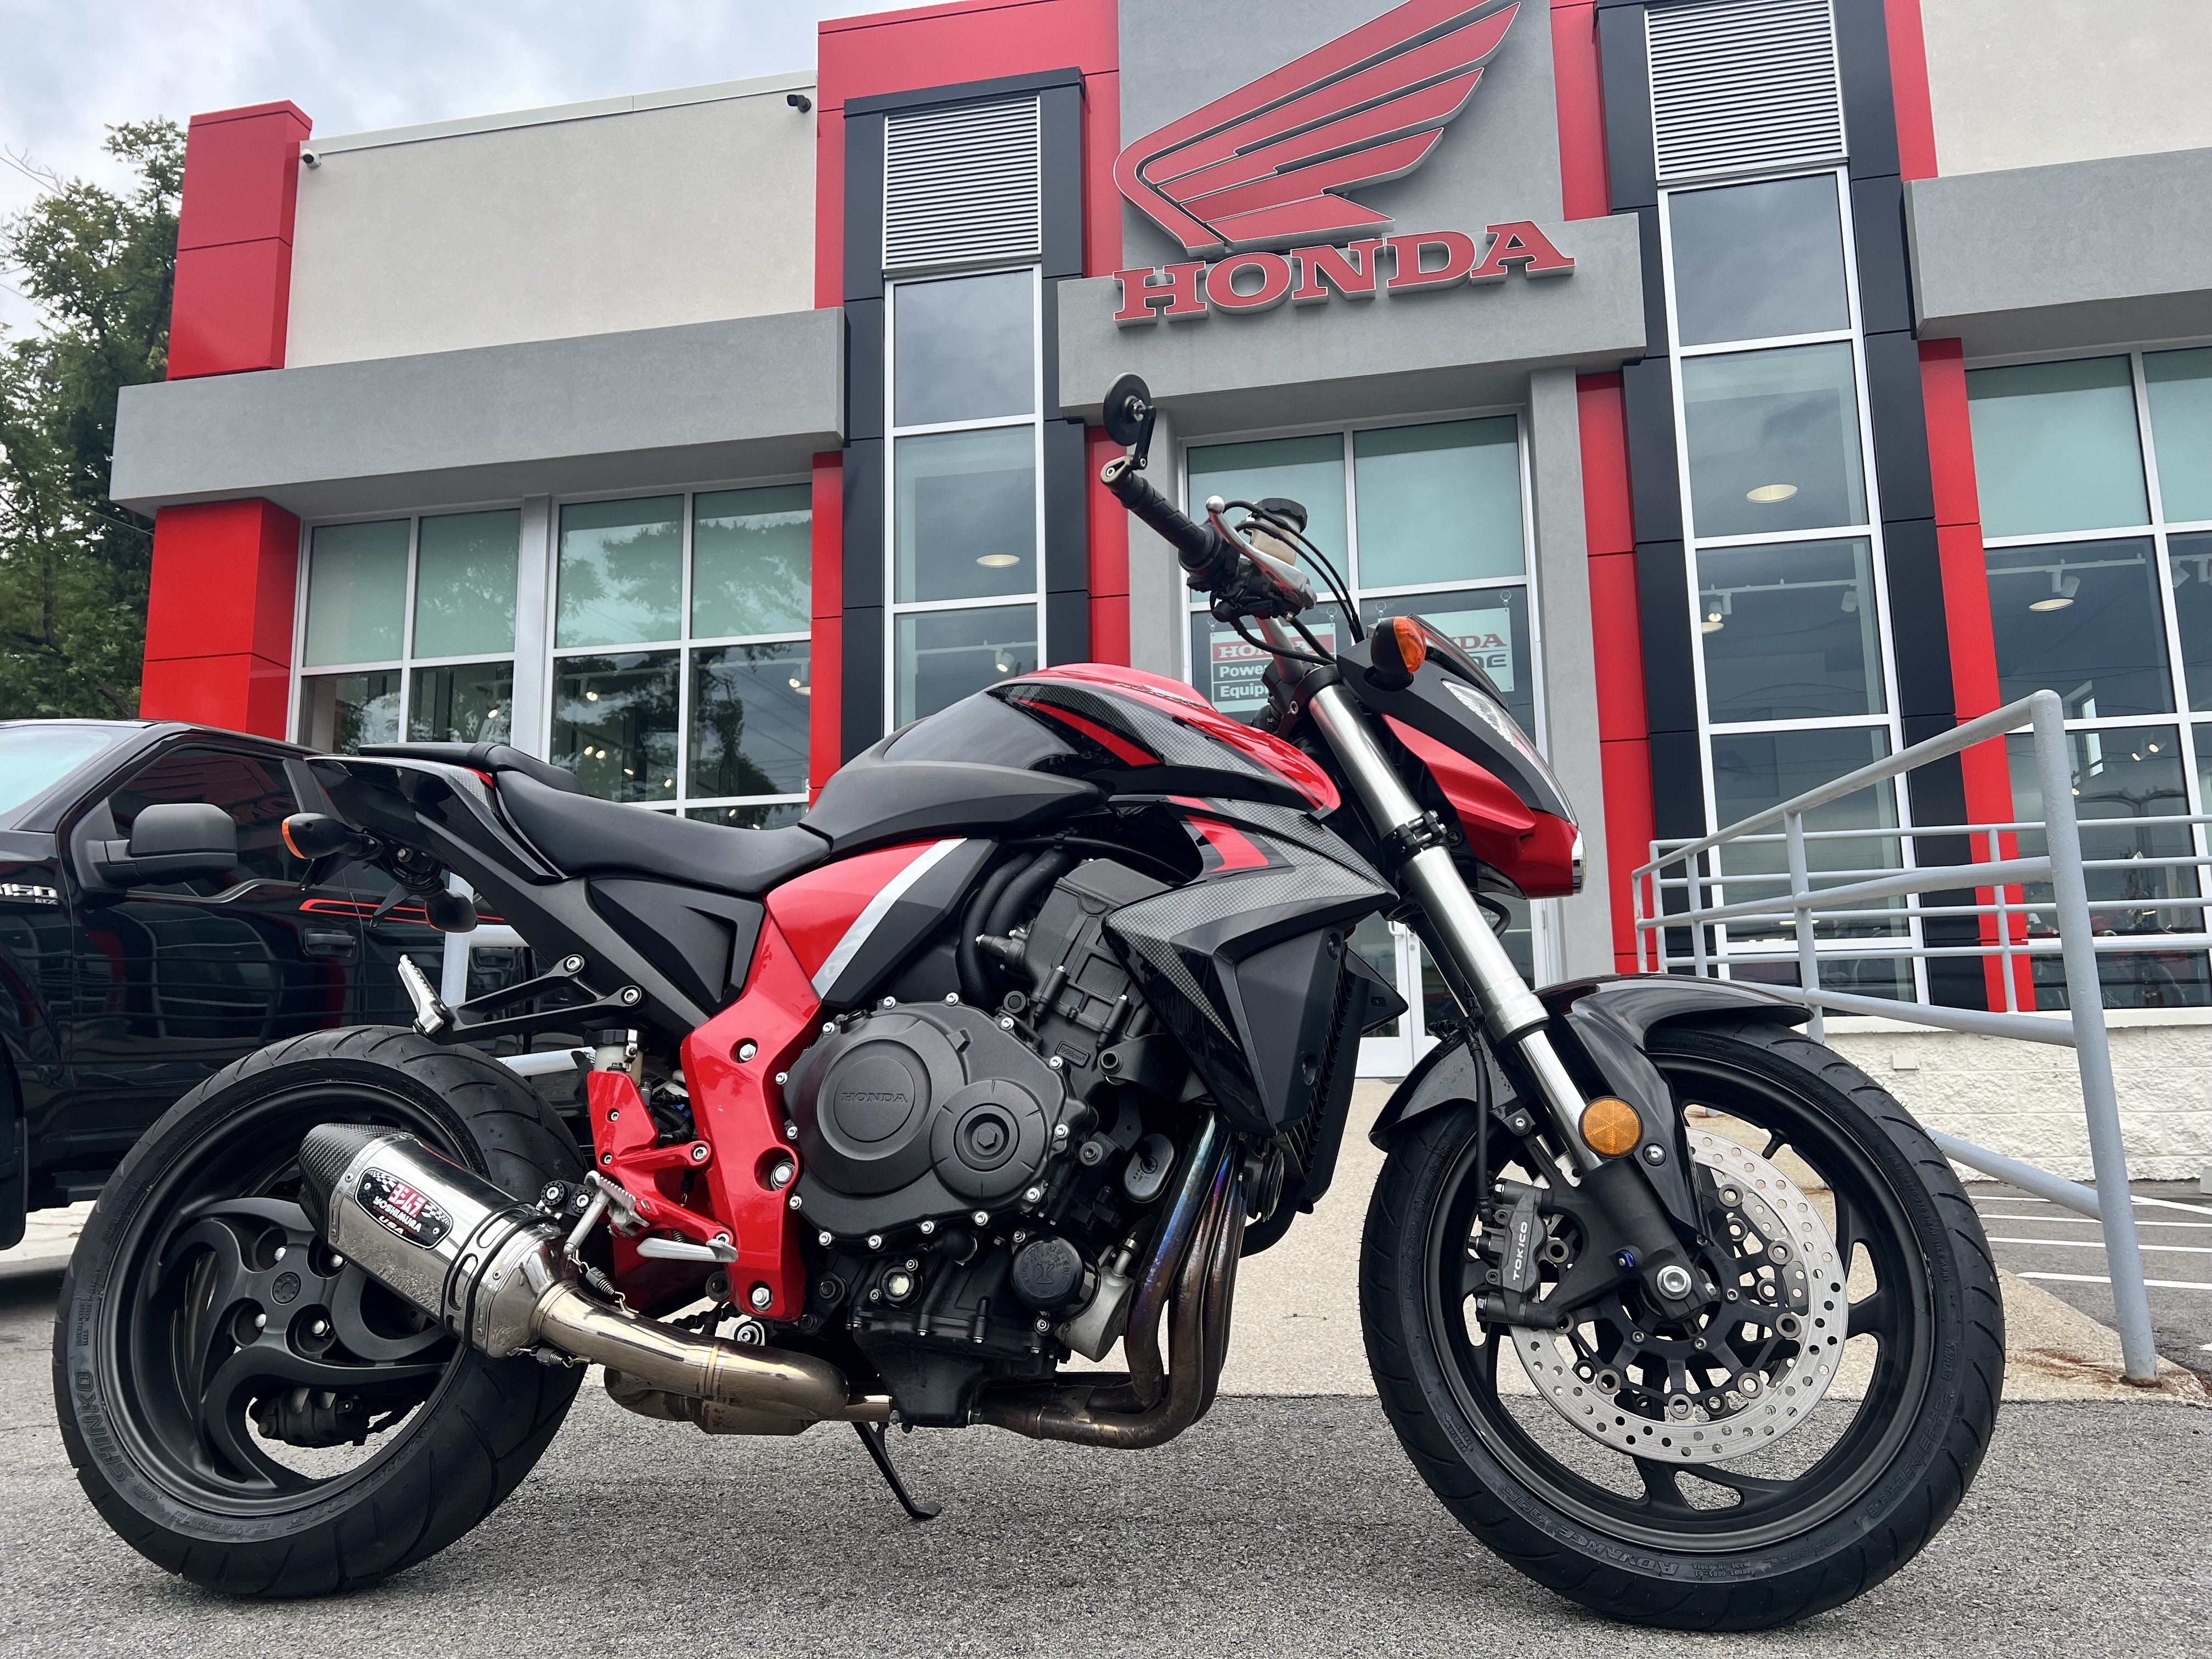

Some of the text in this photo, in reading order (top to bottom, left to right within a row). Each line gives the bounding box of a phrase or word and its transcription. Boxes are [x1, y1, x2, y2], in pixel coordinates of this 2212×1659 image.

[1113, 220, 1575, 328] HONDA
[1218, 641, 1312, 658] HOA
[1220, 664, 1267, 678] Powe
[0, 883, 58, 899] 150
[841, 1092, 908, 1102] HONDA
[373, 1195, 422, 1233] YOSHIMURA
[379, 1215, 404, 1235] USA
[1513, 1221, 1528, 1280] TOKICO
[75, 1370, 135, 1481] SHINKO
[1456, 1423, 1472, 1444] FRONT
[1555, 1525, 1679, 1576] ADVANCE
